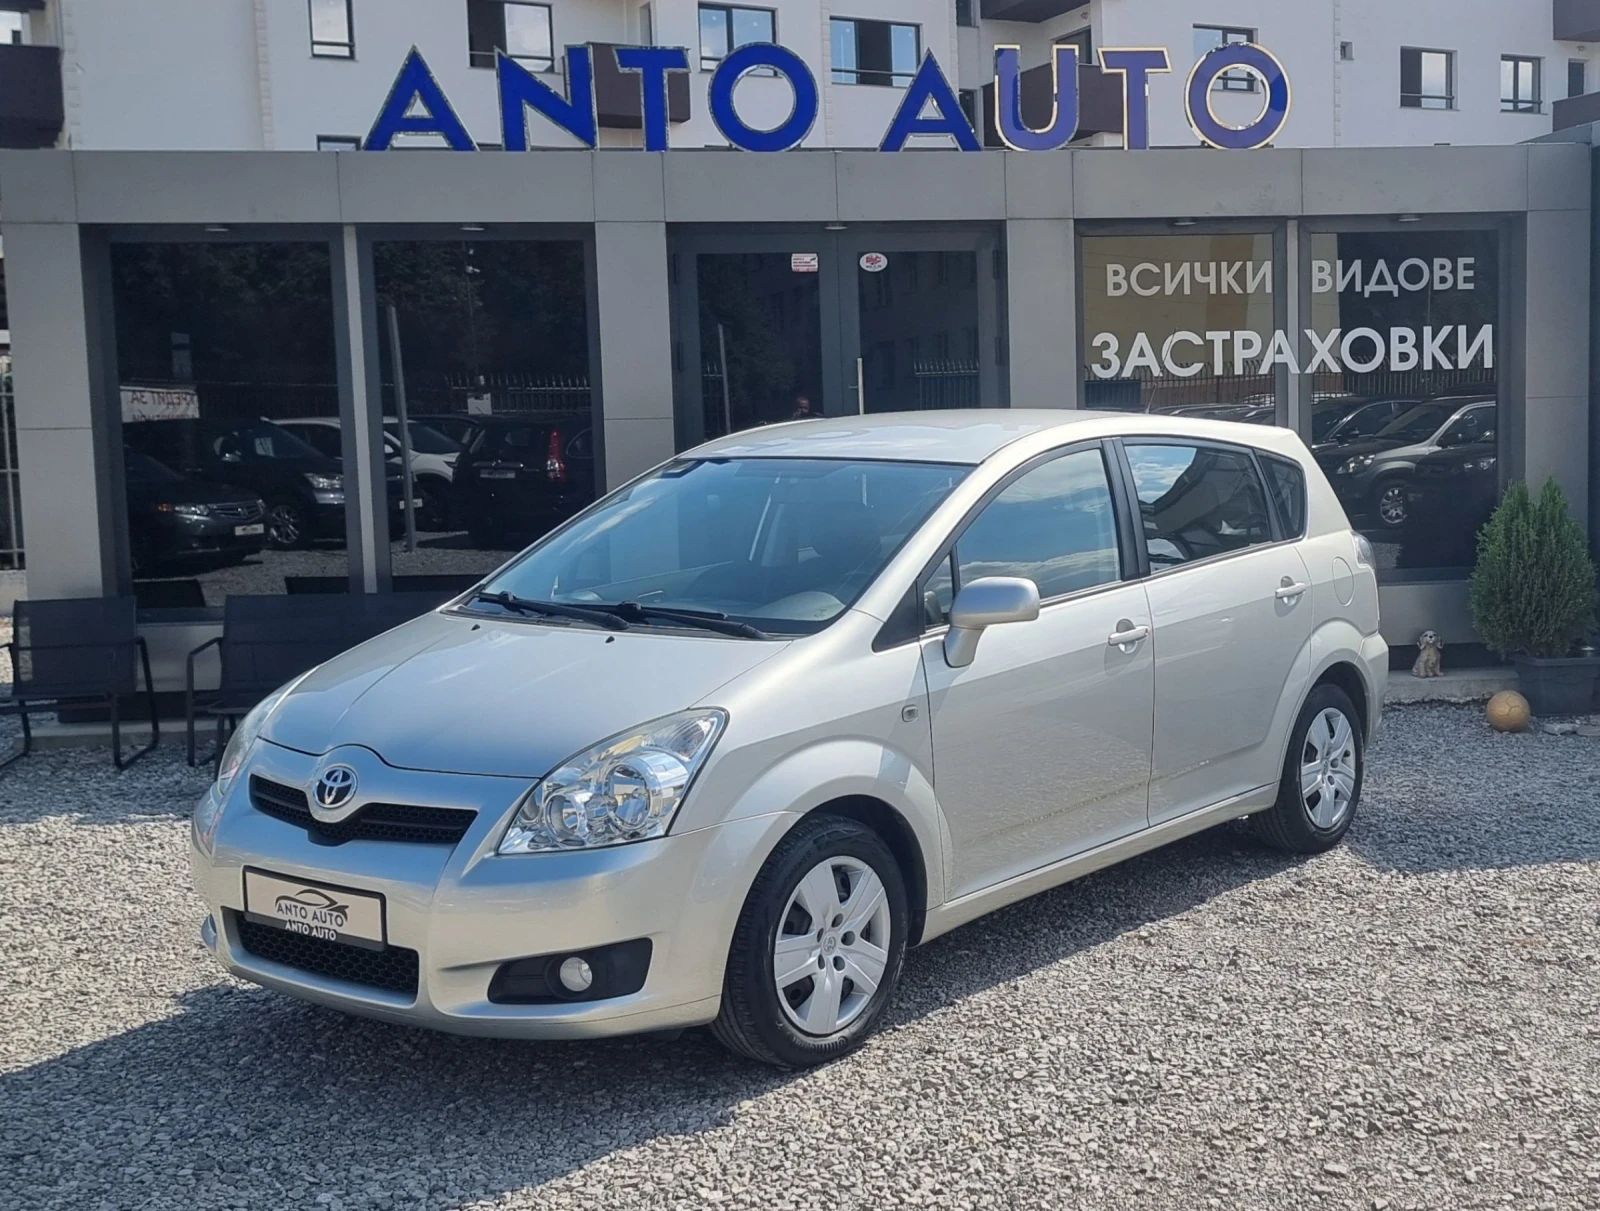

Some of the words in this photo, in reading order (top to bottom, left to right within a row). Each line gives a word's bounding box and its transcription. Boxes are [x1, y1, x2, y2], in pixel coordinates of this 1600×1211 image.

[363, 41, 819, 152] ANTO
[878, 41, 1292, 151] AUTO
[1106, 260, 1272, 297] ВСИЧКИ
[1312, 257, 1475, 297] ВИДОВЕ
[1091, 324, 1493, 378] ЗАСТРАХОВКИ
[277, 902, 308, 919] ANTO
[311, 910, 344, 928] AUTO
[285, 921, 309, 935] ANTO
[311, 927, 336, 941] AUTO
